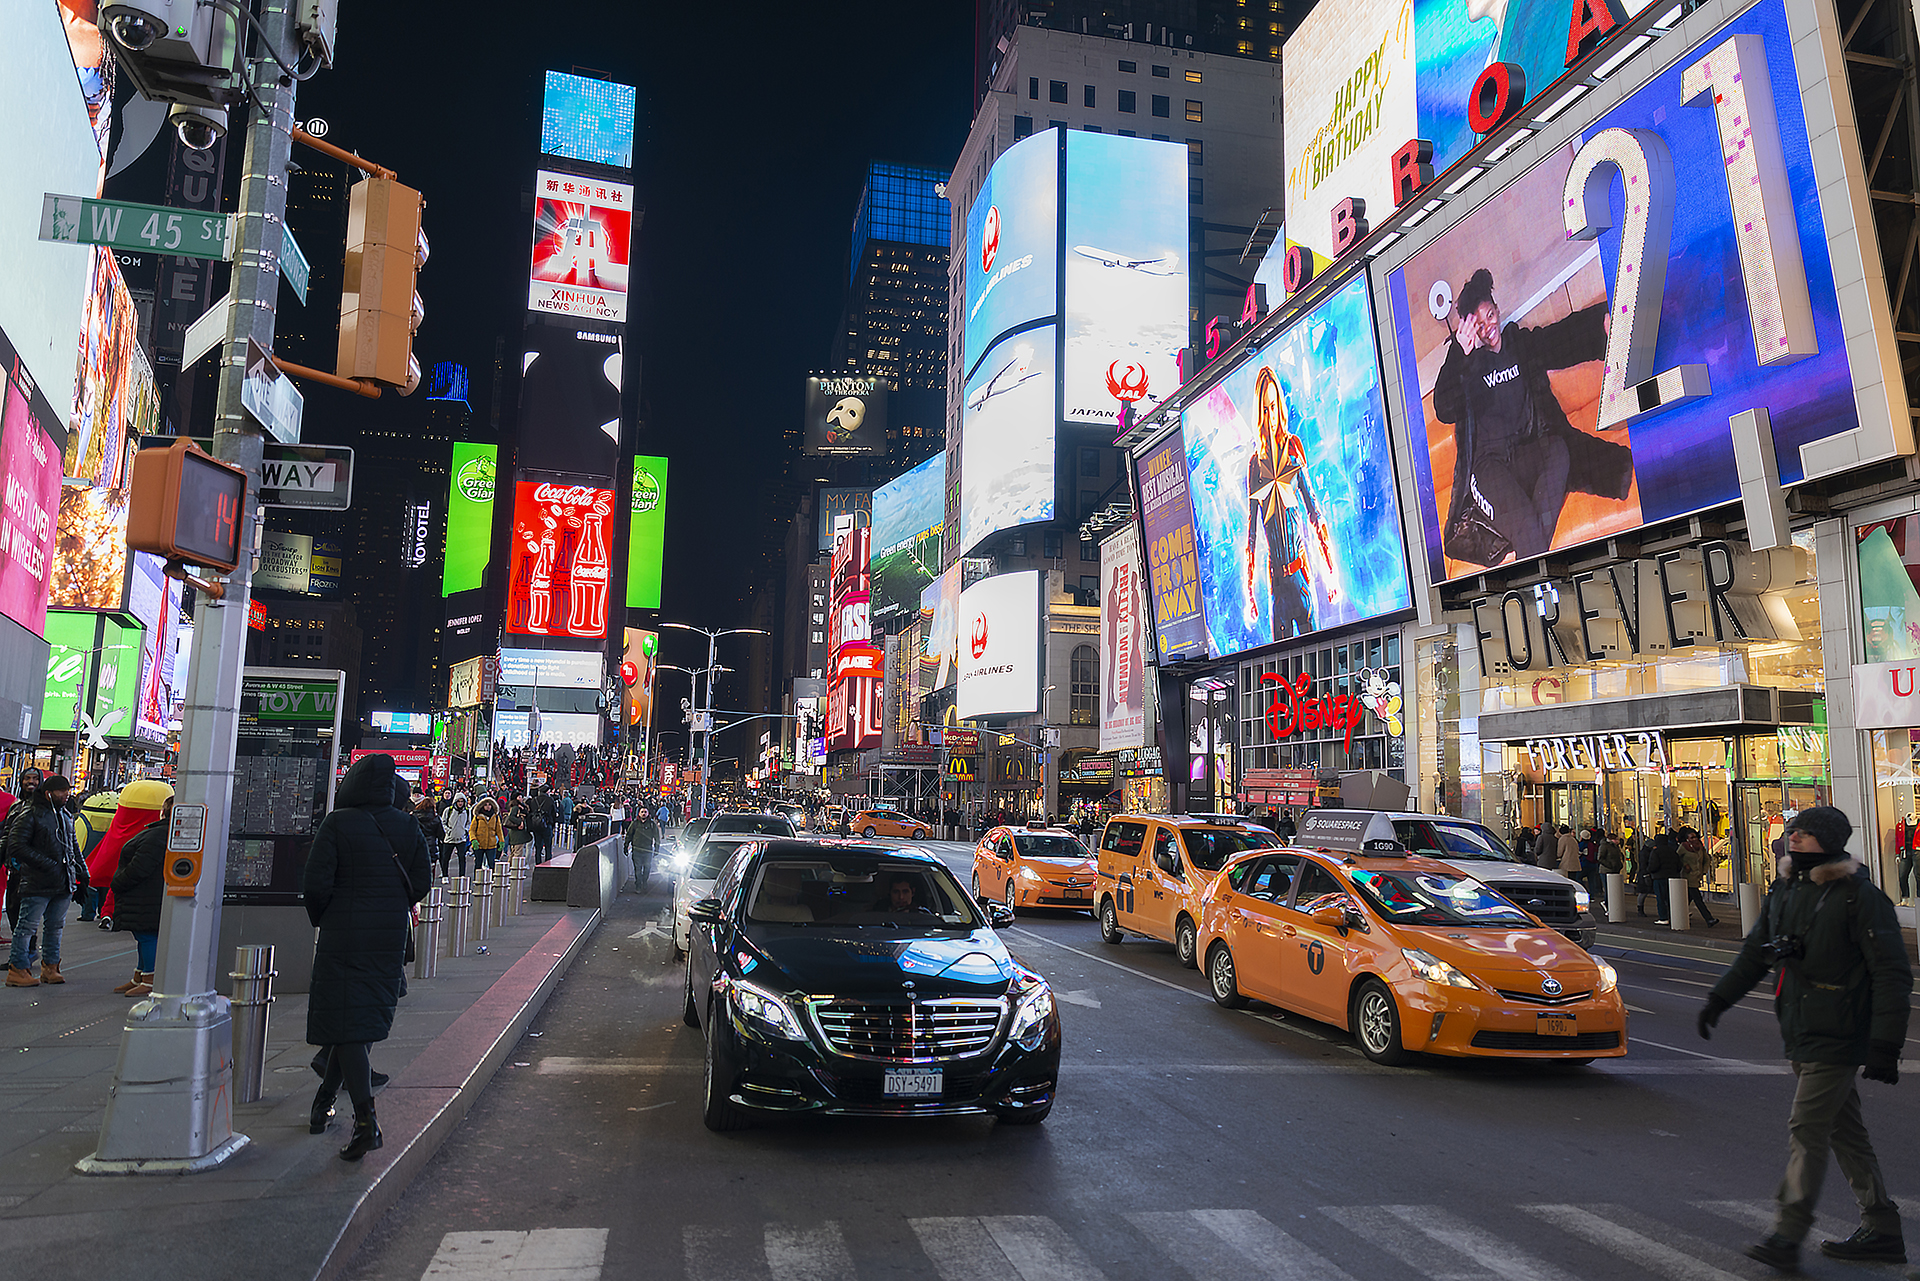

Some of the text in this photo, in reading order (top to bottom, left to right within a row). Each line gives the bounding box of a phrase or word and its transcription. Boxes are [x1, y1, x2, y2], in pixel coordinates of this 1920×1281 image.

[1333, 43, 1384, 128] HAPPY
[1312, 87, 1385, 190] BIRTHDAY
[91, 205, 223, 249] W 45 St
[537, 299, 570, 312] NEWS
[550, 288, 607, 308] XINHUA
[819, 380, 876, 391] PHANTOM
[1482, 363, 1521, 389] Woman
[1115, 388, 1142, 400] JAL
[1069, 407, 1116, 418] JAPAN
[261, 462, 324, 488] WAY
[4, 472, 29, 521] MOST
[825, 493, 850, 509] MY
[215, 491, 238, 550] 14
[412, 500, 430, 569] NOVOTEL
[0, 516, 45, 582] IN WIRELESS
[880, 545, 897, 560] Green
[896, 535, 917, 552] energy
[929, 519, 946, 538] best
[1150, 523, 1193, 568] COME
[262, 556, 299, 567] BROADWAY
[310, 577, 339, 589] FROZEN
[1156, 580, 1198, 625] AWAY
[1470, 540, 1750, 678] FOREVER
[1118, 634, 1129, 705] WOMAN
[1525, 730, 1668, 772] FOREVER 21
[664, 764, 675, 785] tkts
[1316, 819, 1363, 830] SQUARESPACE
[1373, 842, 1394, 851] 1G90
